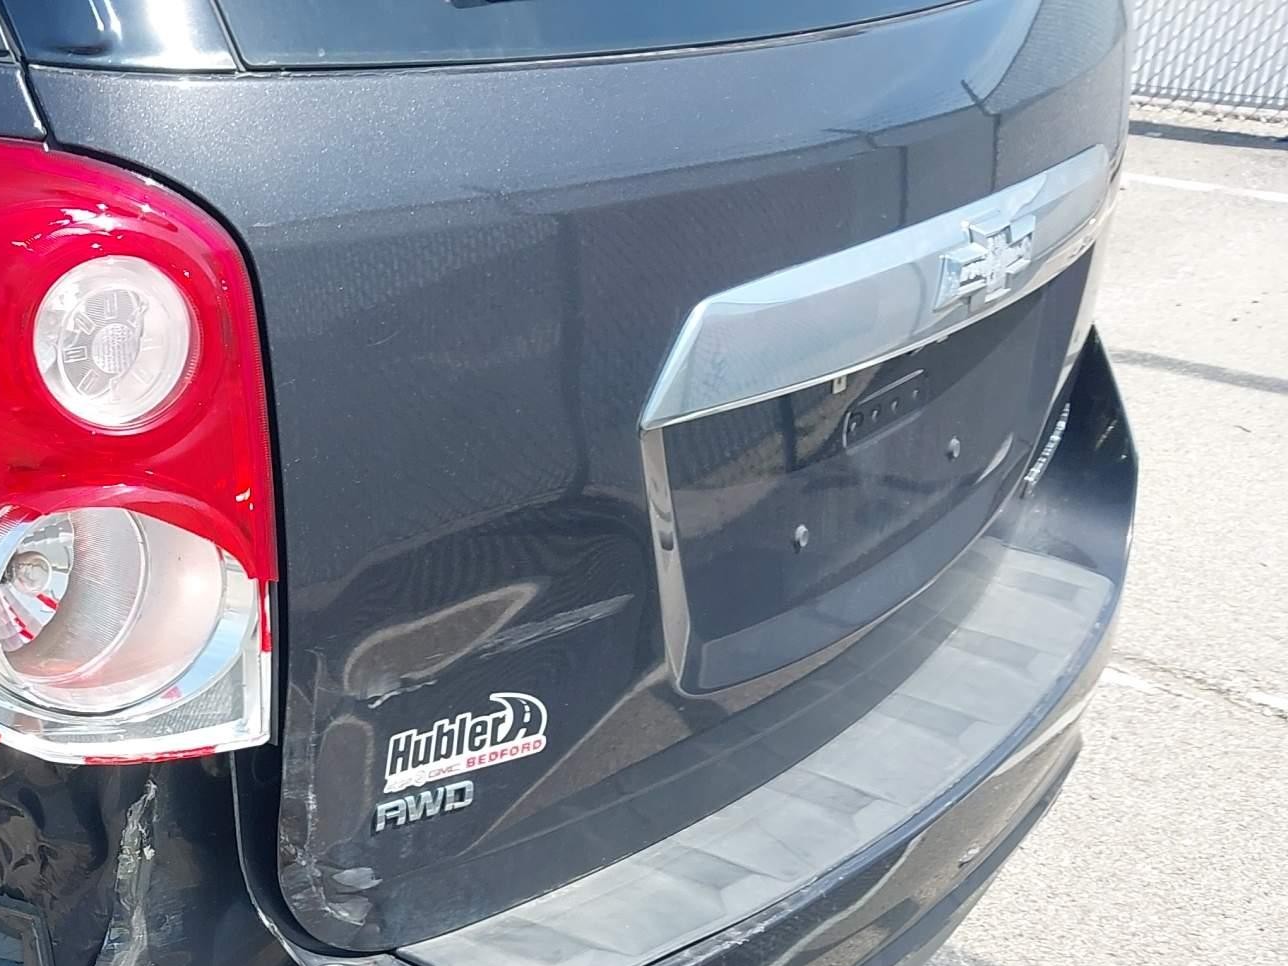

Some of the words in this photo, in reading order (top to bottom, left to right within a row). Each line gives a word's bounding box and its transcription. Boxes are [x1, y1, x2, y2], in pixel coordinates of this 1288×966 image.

[388, 714, 508, 777] Hubler
[465, 739, 543, 769] BEDFORD
[375, 780, 474, 832] AWD
